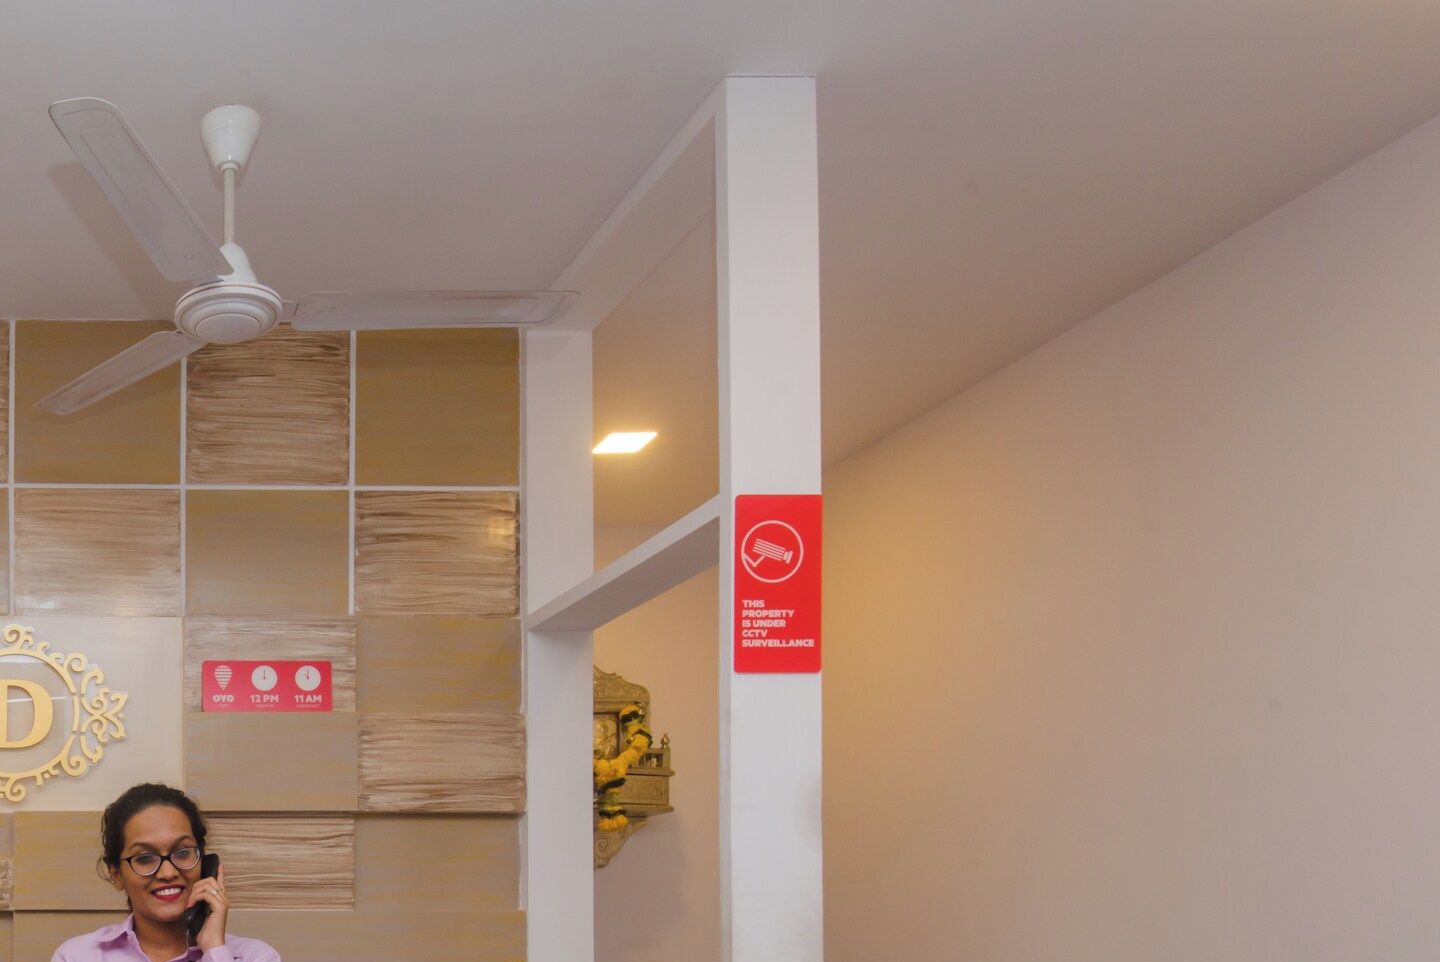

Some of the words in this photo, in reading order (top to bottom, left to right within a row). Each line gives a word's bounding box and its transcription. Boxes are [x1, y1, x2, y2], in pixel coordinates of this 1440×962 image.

[742, 599, 765, 608] THIS
[742, 609, 795, 618] PROPERTY
[742, 619, 751, 628] IS
[752, 619, 786, 628] UNDER
[742, 629, 768, 638] CCTV
[742, 639, 815, 648] SURVEILLANCE
[212, 694, 235, 703] OYO
[250, 694, 263, 703] 12
[263, 694, 279, 703] PM
[304, 694, 322, 703] AM
